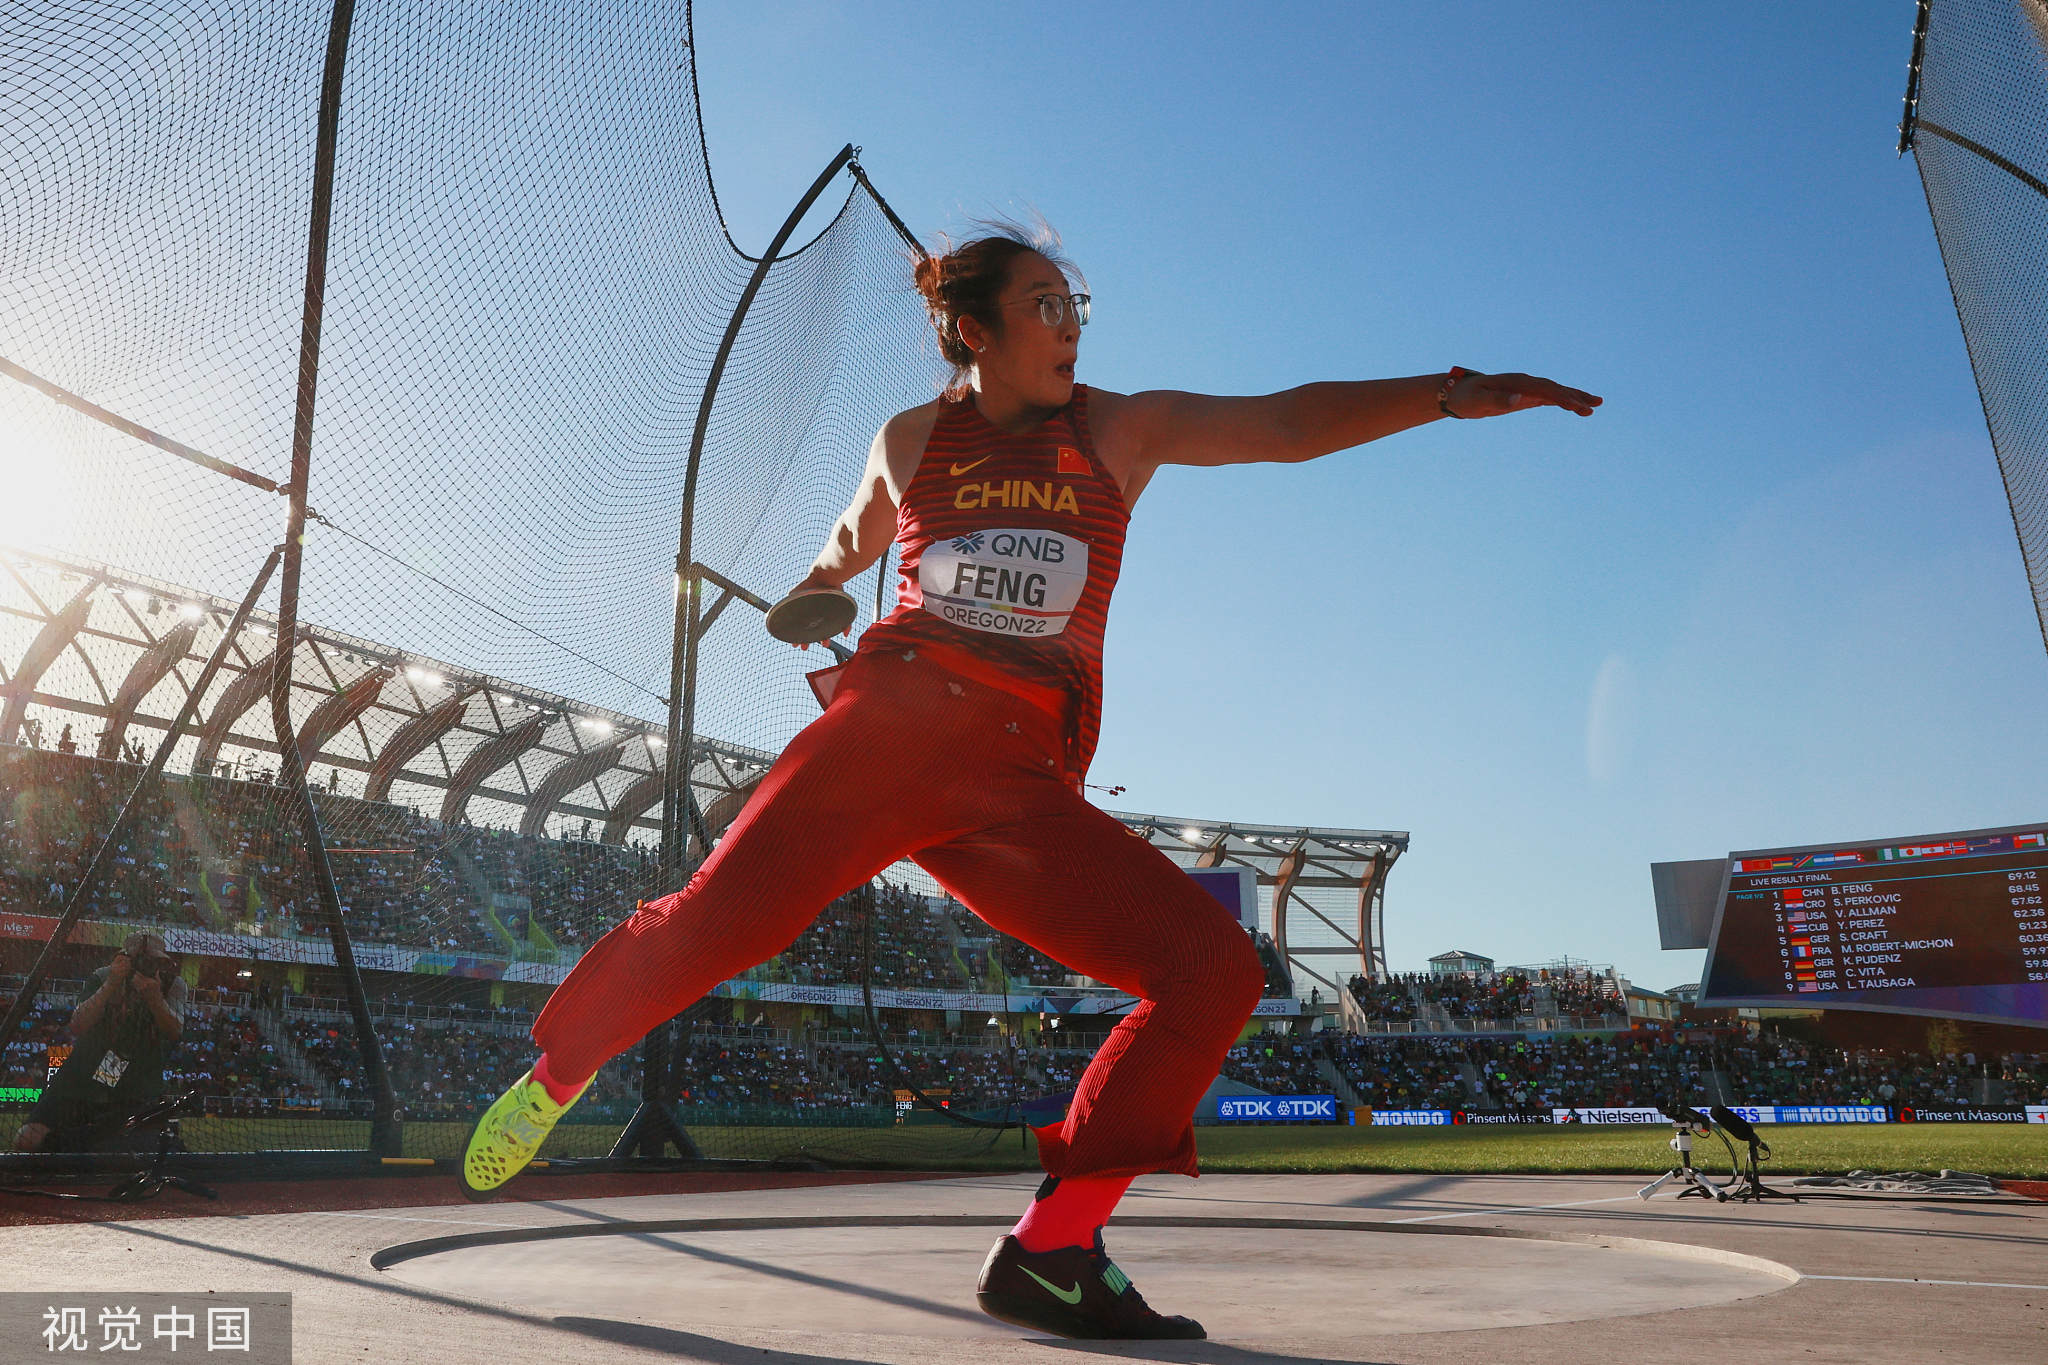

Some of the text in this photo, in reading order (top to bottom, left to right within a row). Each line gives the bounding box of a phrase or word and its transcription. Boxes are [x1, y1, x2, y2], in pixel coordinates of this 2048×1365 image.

[953, 480, 1080, 515] CHINA
[991, 533, 1065, 563] QNB
[953, 562, 1047, 608] FENG
[943, 605, 1047, 634] OREGON22
[1750, 873, 1833, 886] LIVE RESULT FINAL
[1772, 871, 2037, 899] 1 CHN B. FENG 69.12
[1773, 883, 2040, 911] 2 CRO S. PERKOVIC 68.45
[1775, 896, 2042, 922] 3 USA V. ALLMAN 67.62
[1777, 908, 2046, 934] 4 CUB Y. PEREZ 62.36
[1779, 920, 2048, 946] 5 GER S. CRAFT 61.23
[174, 938, 246, 954] OREGON22
[1780, 948, 1789, 957] 6
[1812, 946, 1832, 955] FRA
[1841, 944, 1852, 954] M.
[1855, 938, 1955, 952] ROBERT-MICHON
[1782, 946, 2048, 969] 7 GER K. PUDENZ 59.9
[1784, 971, 1792, 980] 8
[1815, 970, 1837, 979] GER
[1845, 968, 1856, 978] C.
[1858, 966, 1886, 977] VITA
[1786, 972, 2048, 992] 9 USA L. TAUSAGA 56.
[791, 991, 837, 1002] OREGON22
[1233, 1100, 1332, 1116] TDK TDK
[1587, 1109, 1654, 1123] Nielsen
[1800, 1107, 1887, 1123] MONDO
[1915, 1108, 2024, 1122] Pinsent Masons
[1372, 1111, 1445, 1125] MONDO
[1467, 1112, 1507, 1124] Pinsent
